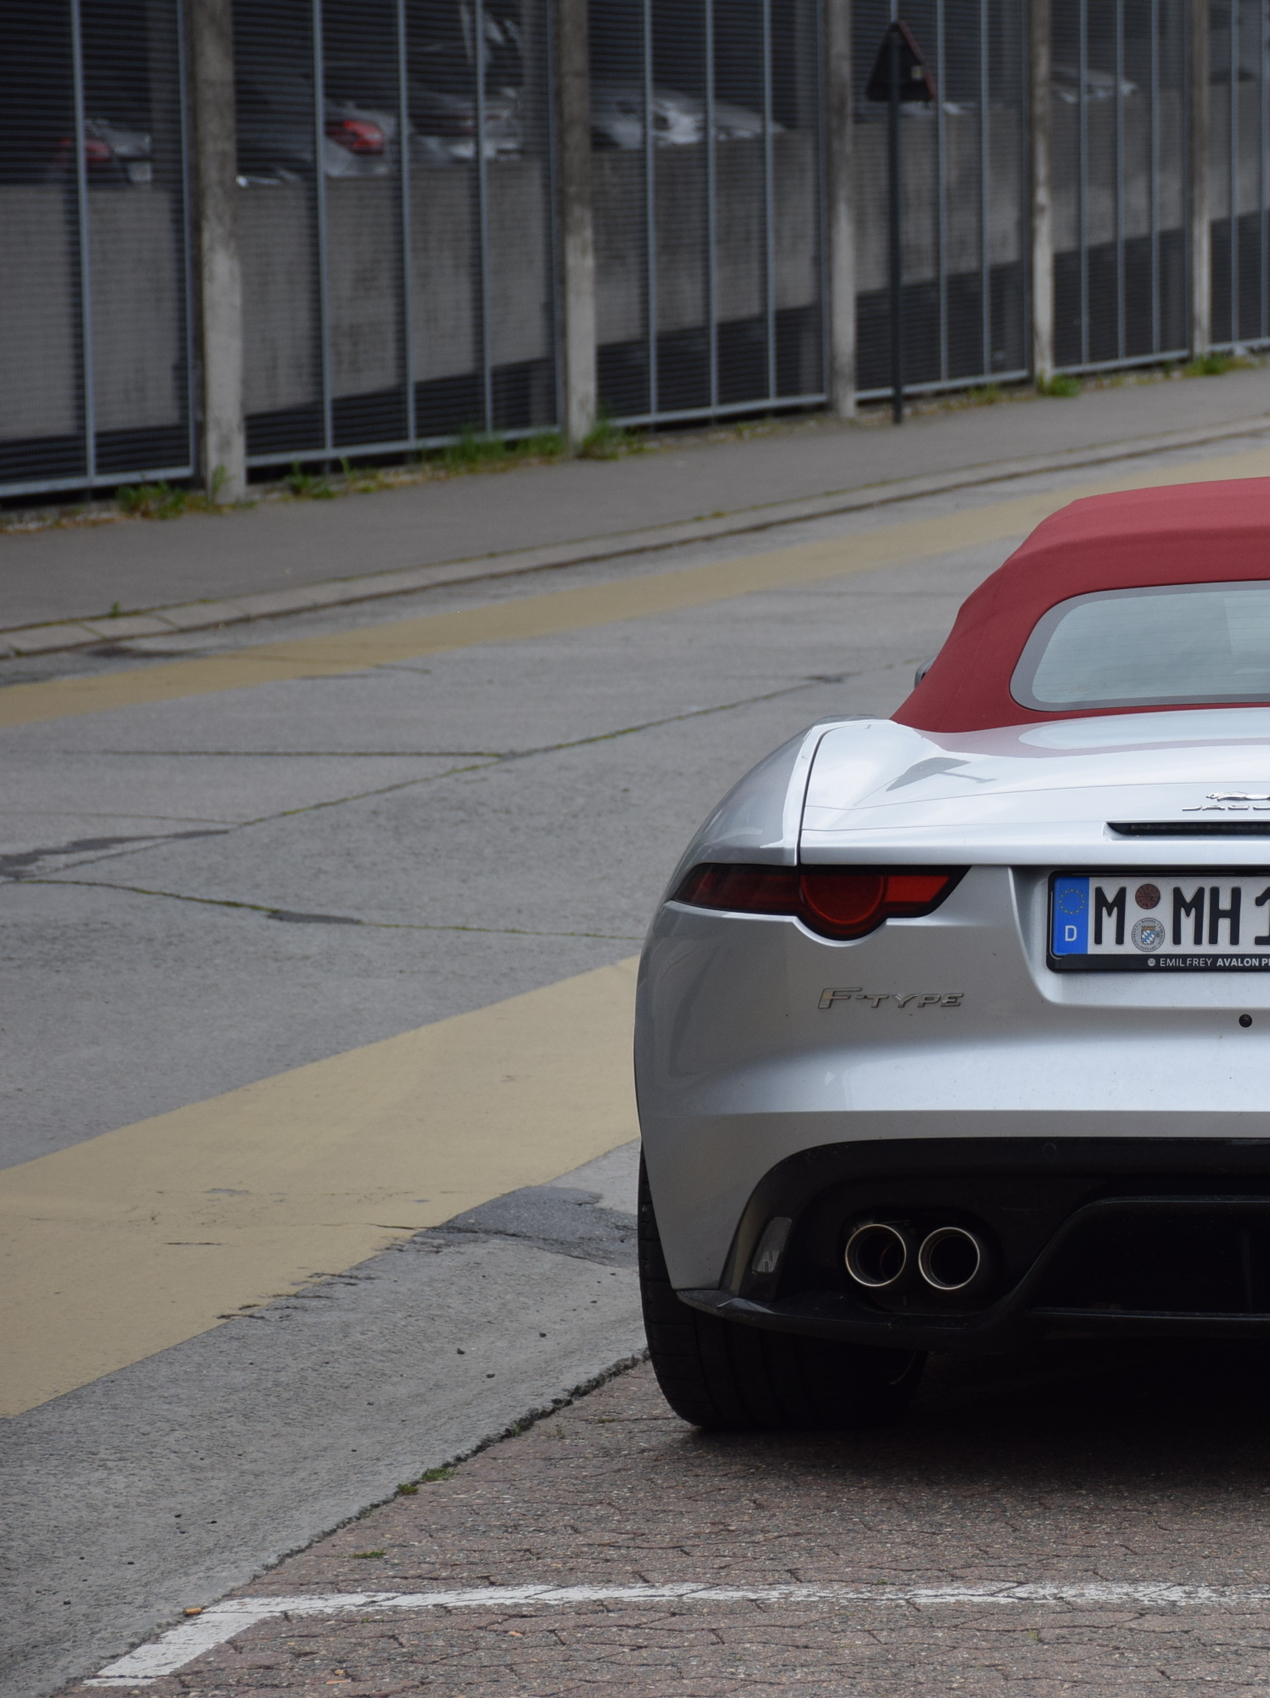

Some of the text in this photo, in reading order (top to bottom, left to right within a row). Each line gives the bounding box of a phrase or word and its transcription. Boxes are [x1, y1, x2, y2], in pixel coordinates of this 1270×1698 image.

[1094, 886, 1126, 945] M
[1065, 926, 1078, 941] D
[1159, 957, 1185, 967] EMIL
[1186, 957, 1213, 967] FREY
[1216, 957, 1260, 967] AVALON
[818, 988, 964, 1009] F-TYPE
